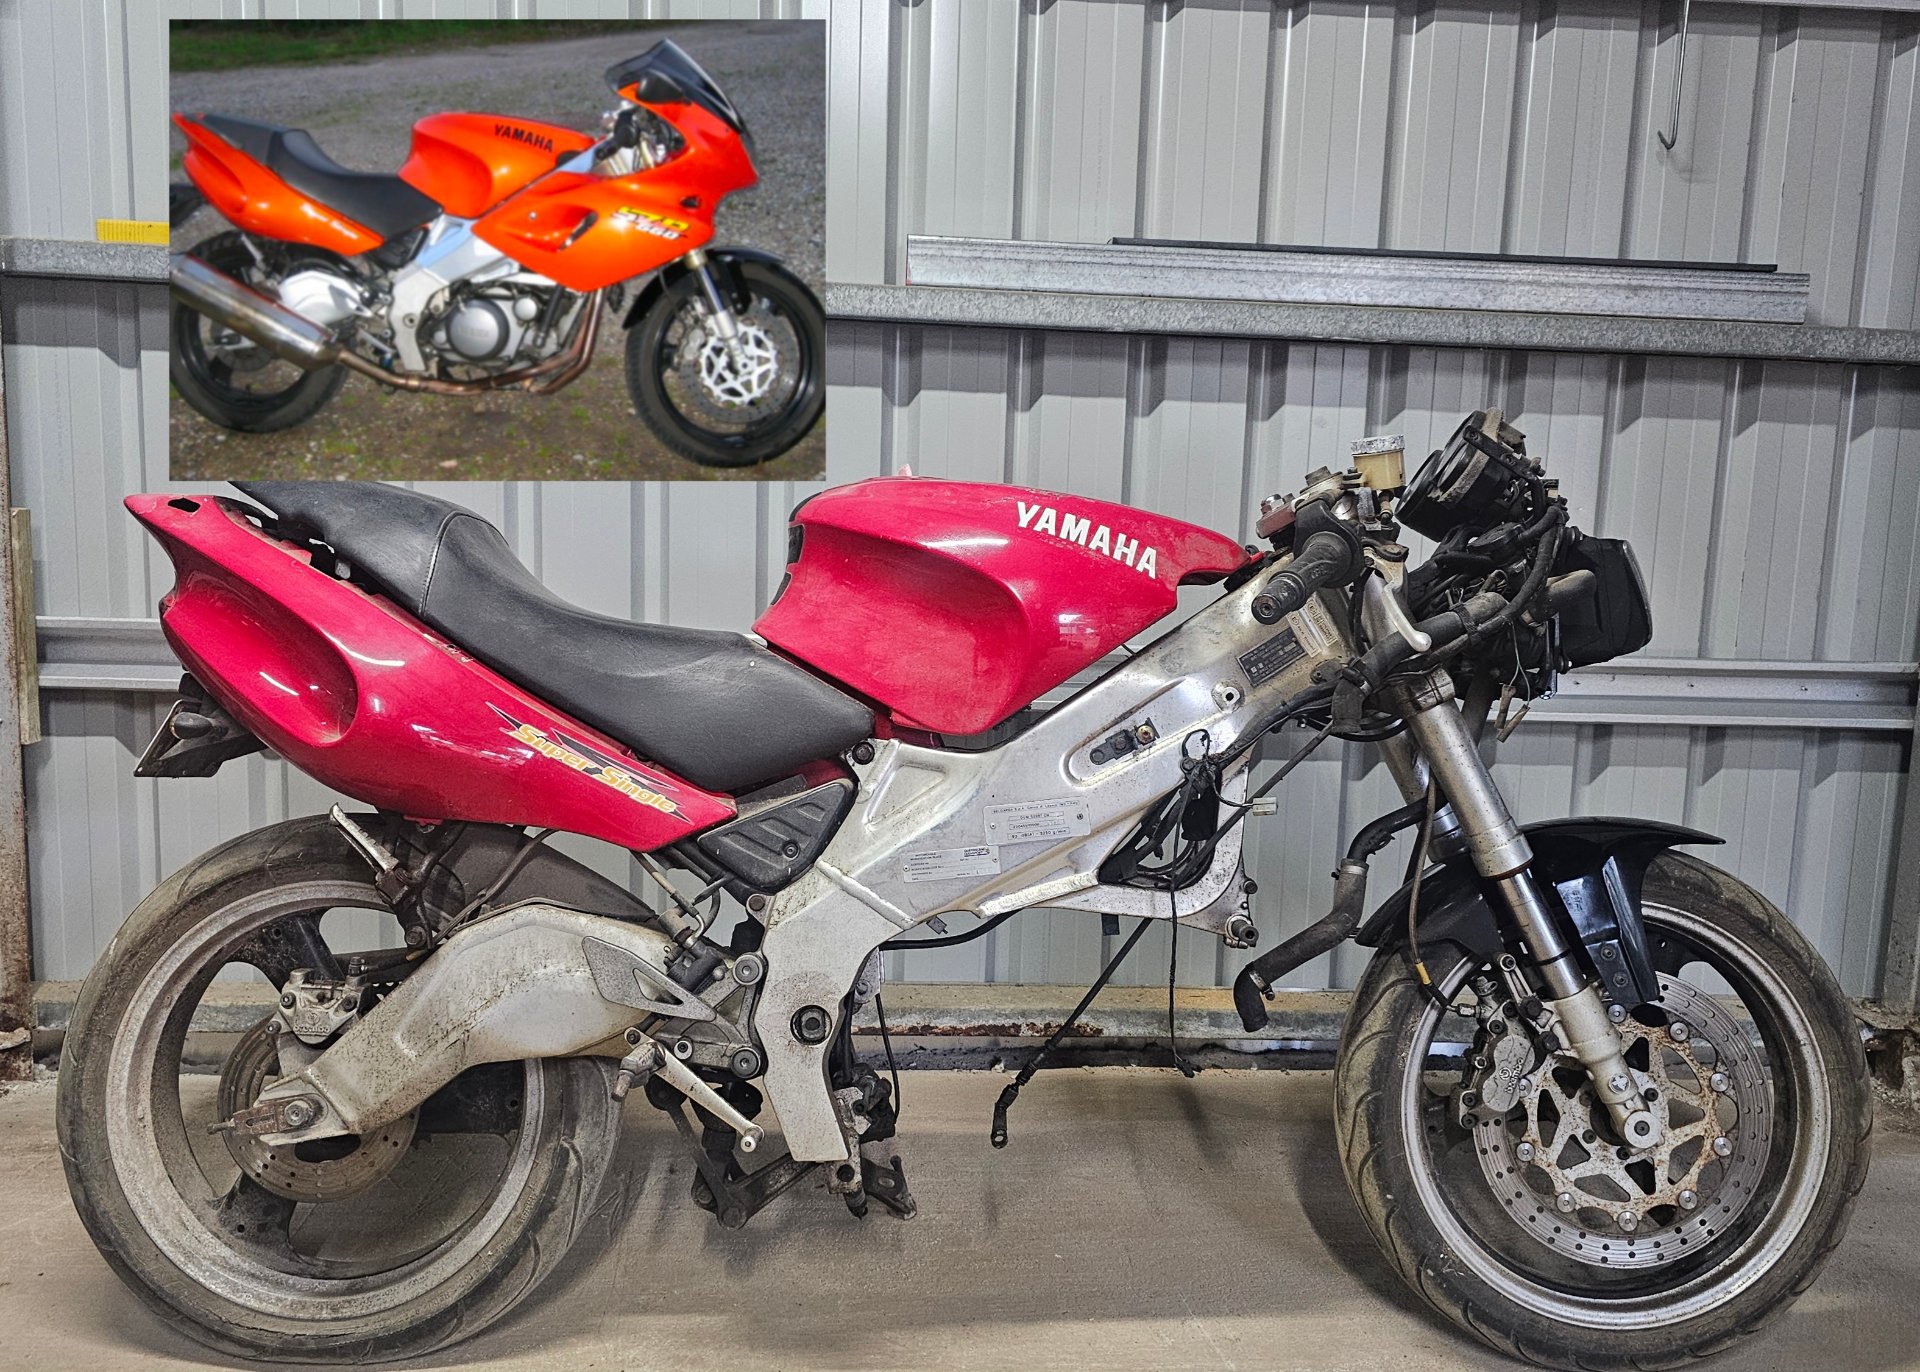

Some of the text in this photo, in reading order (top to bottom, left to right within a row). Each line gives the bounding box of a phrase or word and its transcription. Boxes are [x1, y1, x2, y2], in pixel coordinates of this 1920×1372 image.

[495, 124, 553, 153] YAMAHA
[1017, 501, 1157, 579] YAMAHA
[511, 724, 677, 813] Super Single
[1504, 1058, 1524, 1094] brembo
